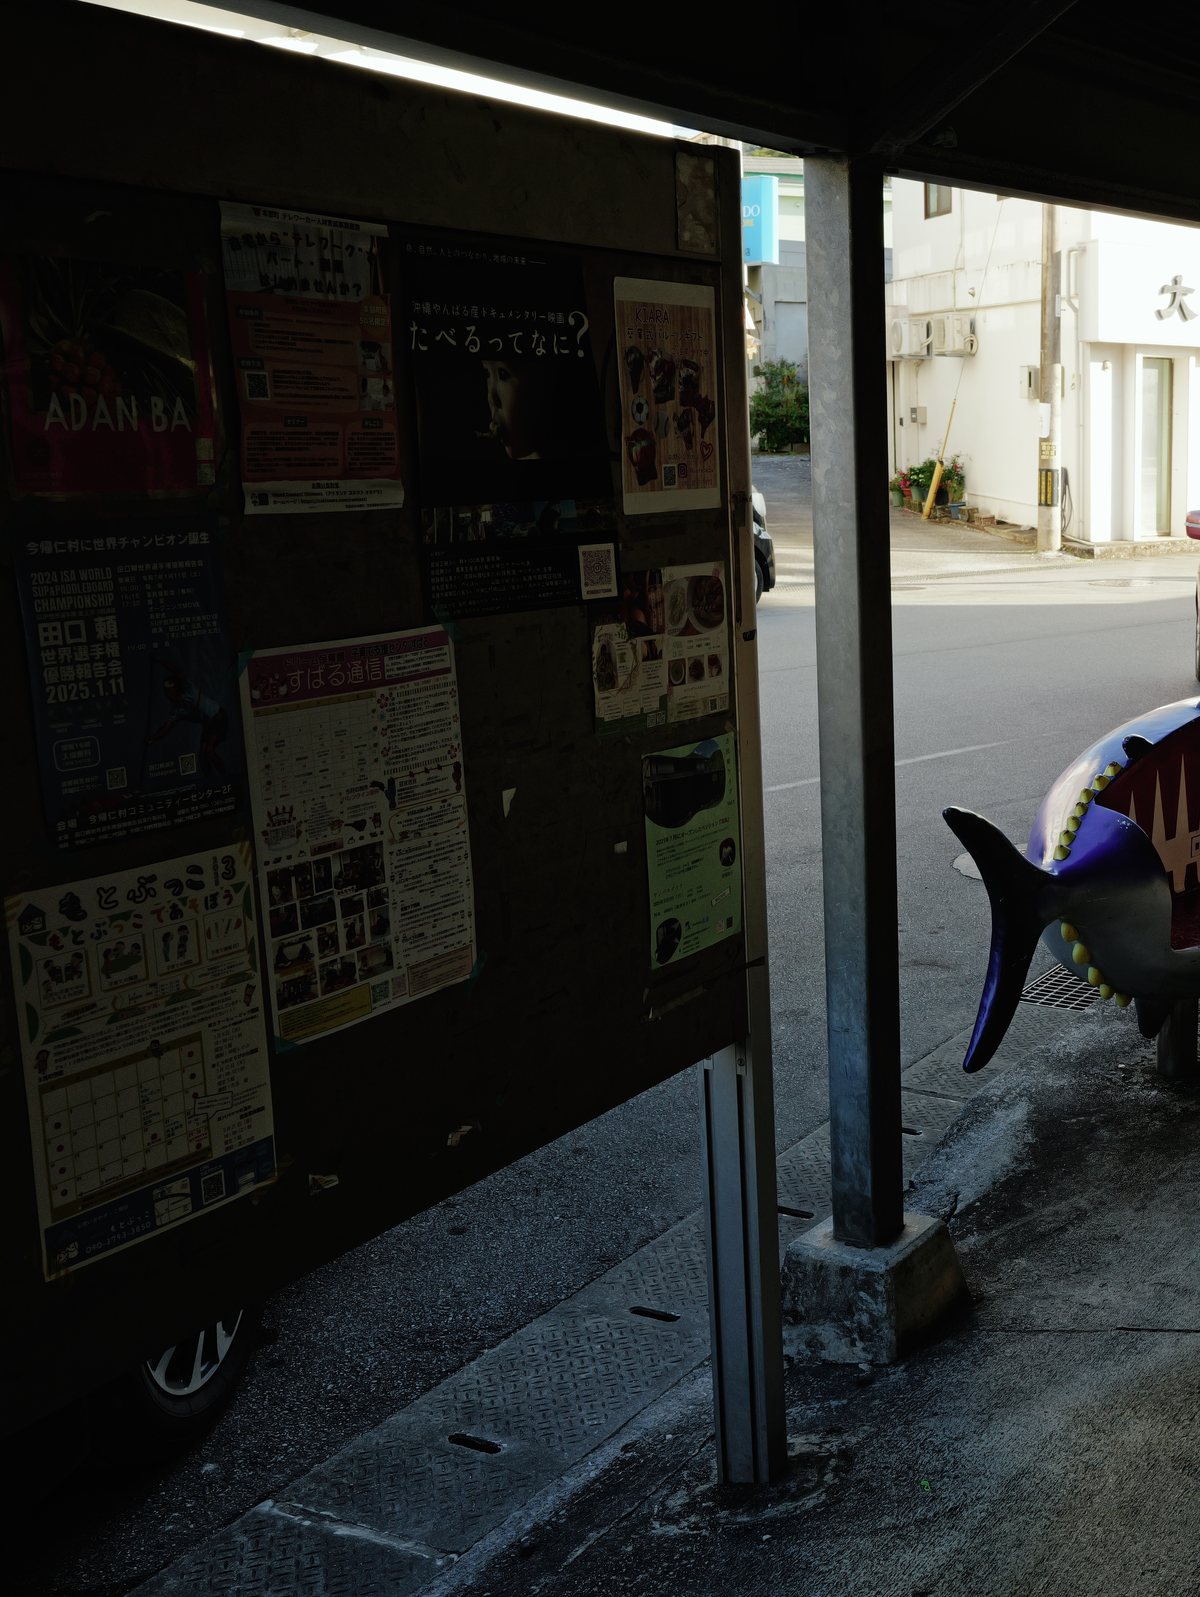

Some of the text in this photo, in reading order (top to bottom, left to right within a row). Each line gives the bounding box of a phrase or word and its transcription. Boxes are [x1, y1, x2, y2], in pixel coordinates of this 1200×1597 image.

[634, 308, 670, 325] KIARA
[43, 391, 193, 433] ADAN BA
[26, 531, 211, 556] 今帰仁村に世界チャンピオン誕生
[31, 570, 58, 586] 2024
[79, 566, 113, 582] WORLD
[34, 592, 115, 614] CHAMPIONSHIP
[37, 618, 88, 648] 田口
[40, 640, 121, 667] 世界選手権
[43, 657, 124, 684] 優勝報告会
[286, 657, 383, 694] すばる通信
[45, 675, 126, 705] 2025.1.11
[58, 863, 206, 922] もとぶっこ
[220, 855, 236, 881] 3
[48, 888, 235, 951] もとぶっこであそぼう
